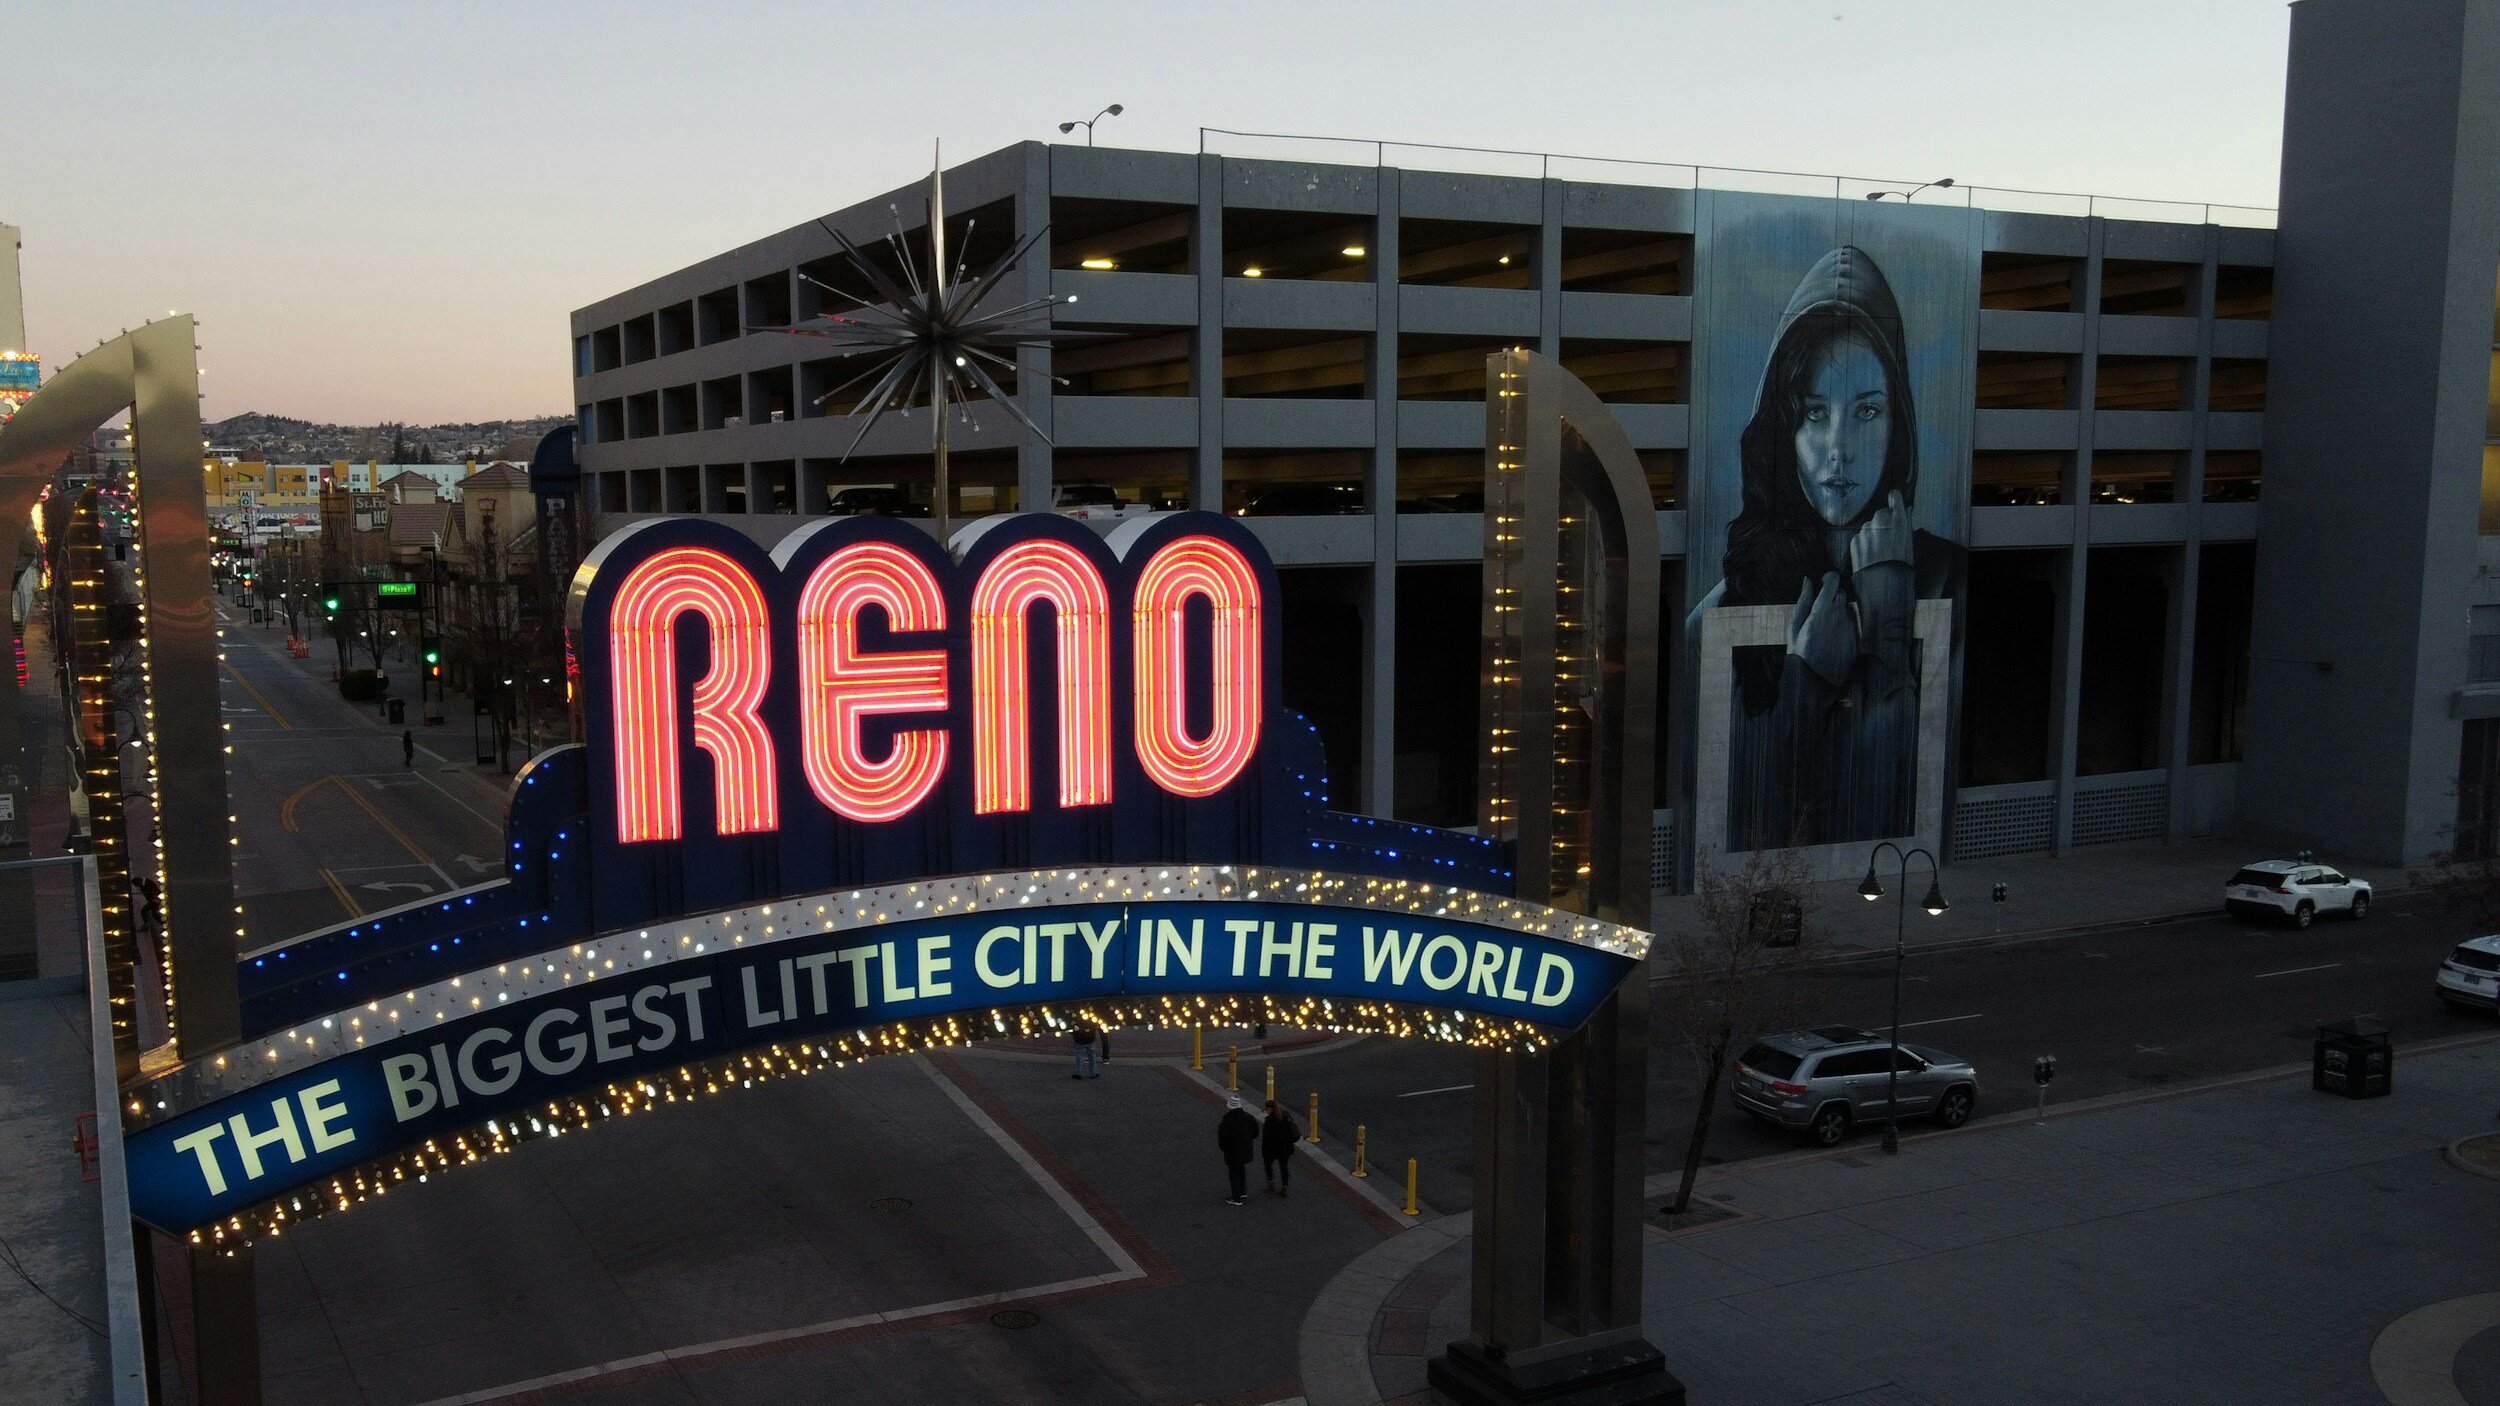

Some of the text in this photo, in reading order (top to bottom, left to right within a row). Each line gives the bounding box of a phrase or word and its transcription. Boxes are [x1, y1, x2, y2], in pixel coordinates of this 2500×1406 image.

[610, 535, 1262, 843] RENO
[174, 919, 1574, 1196] THE BIGGEST LITTLE CITY IN THE WORLD
